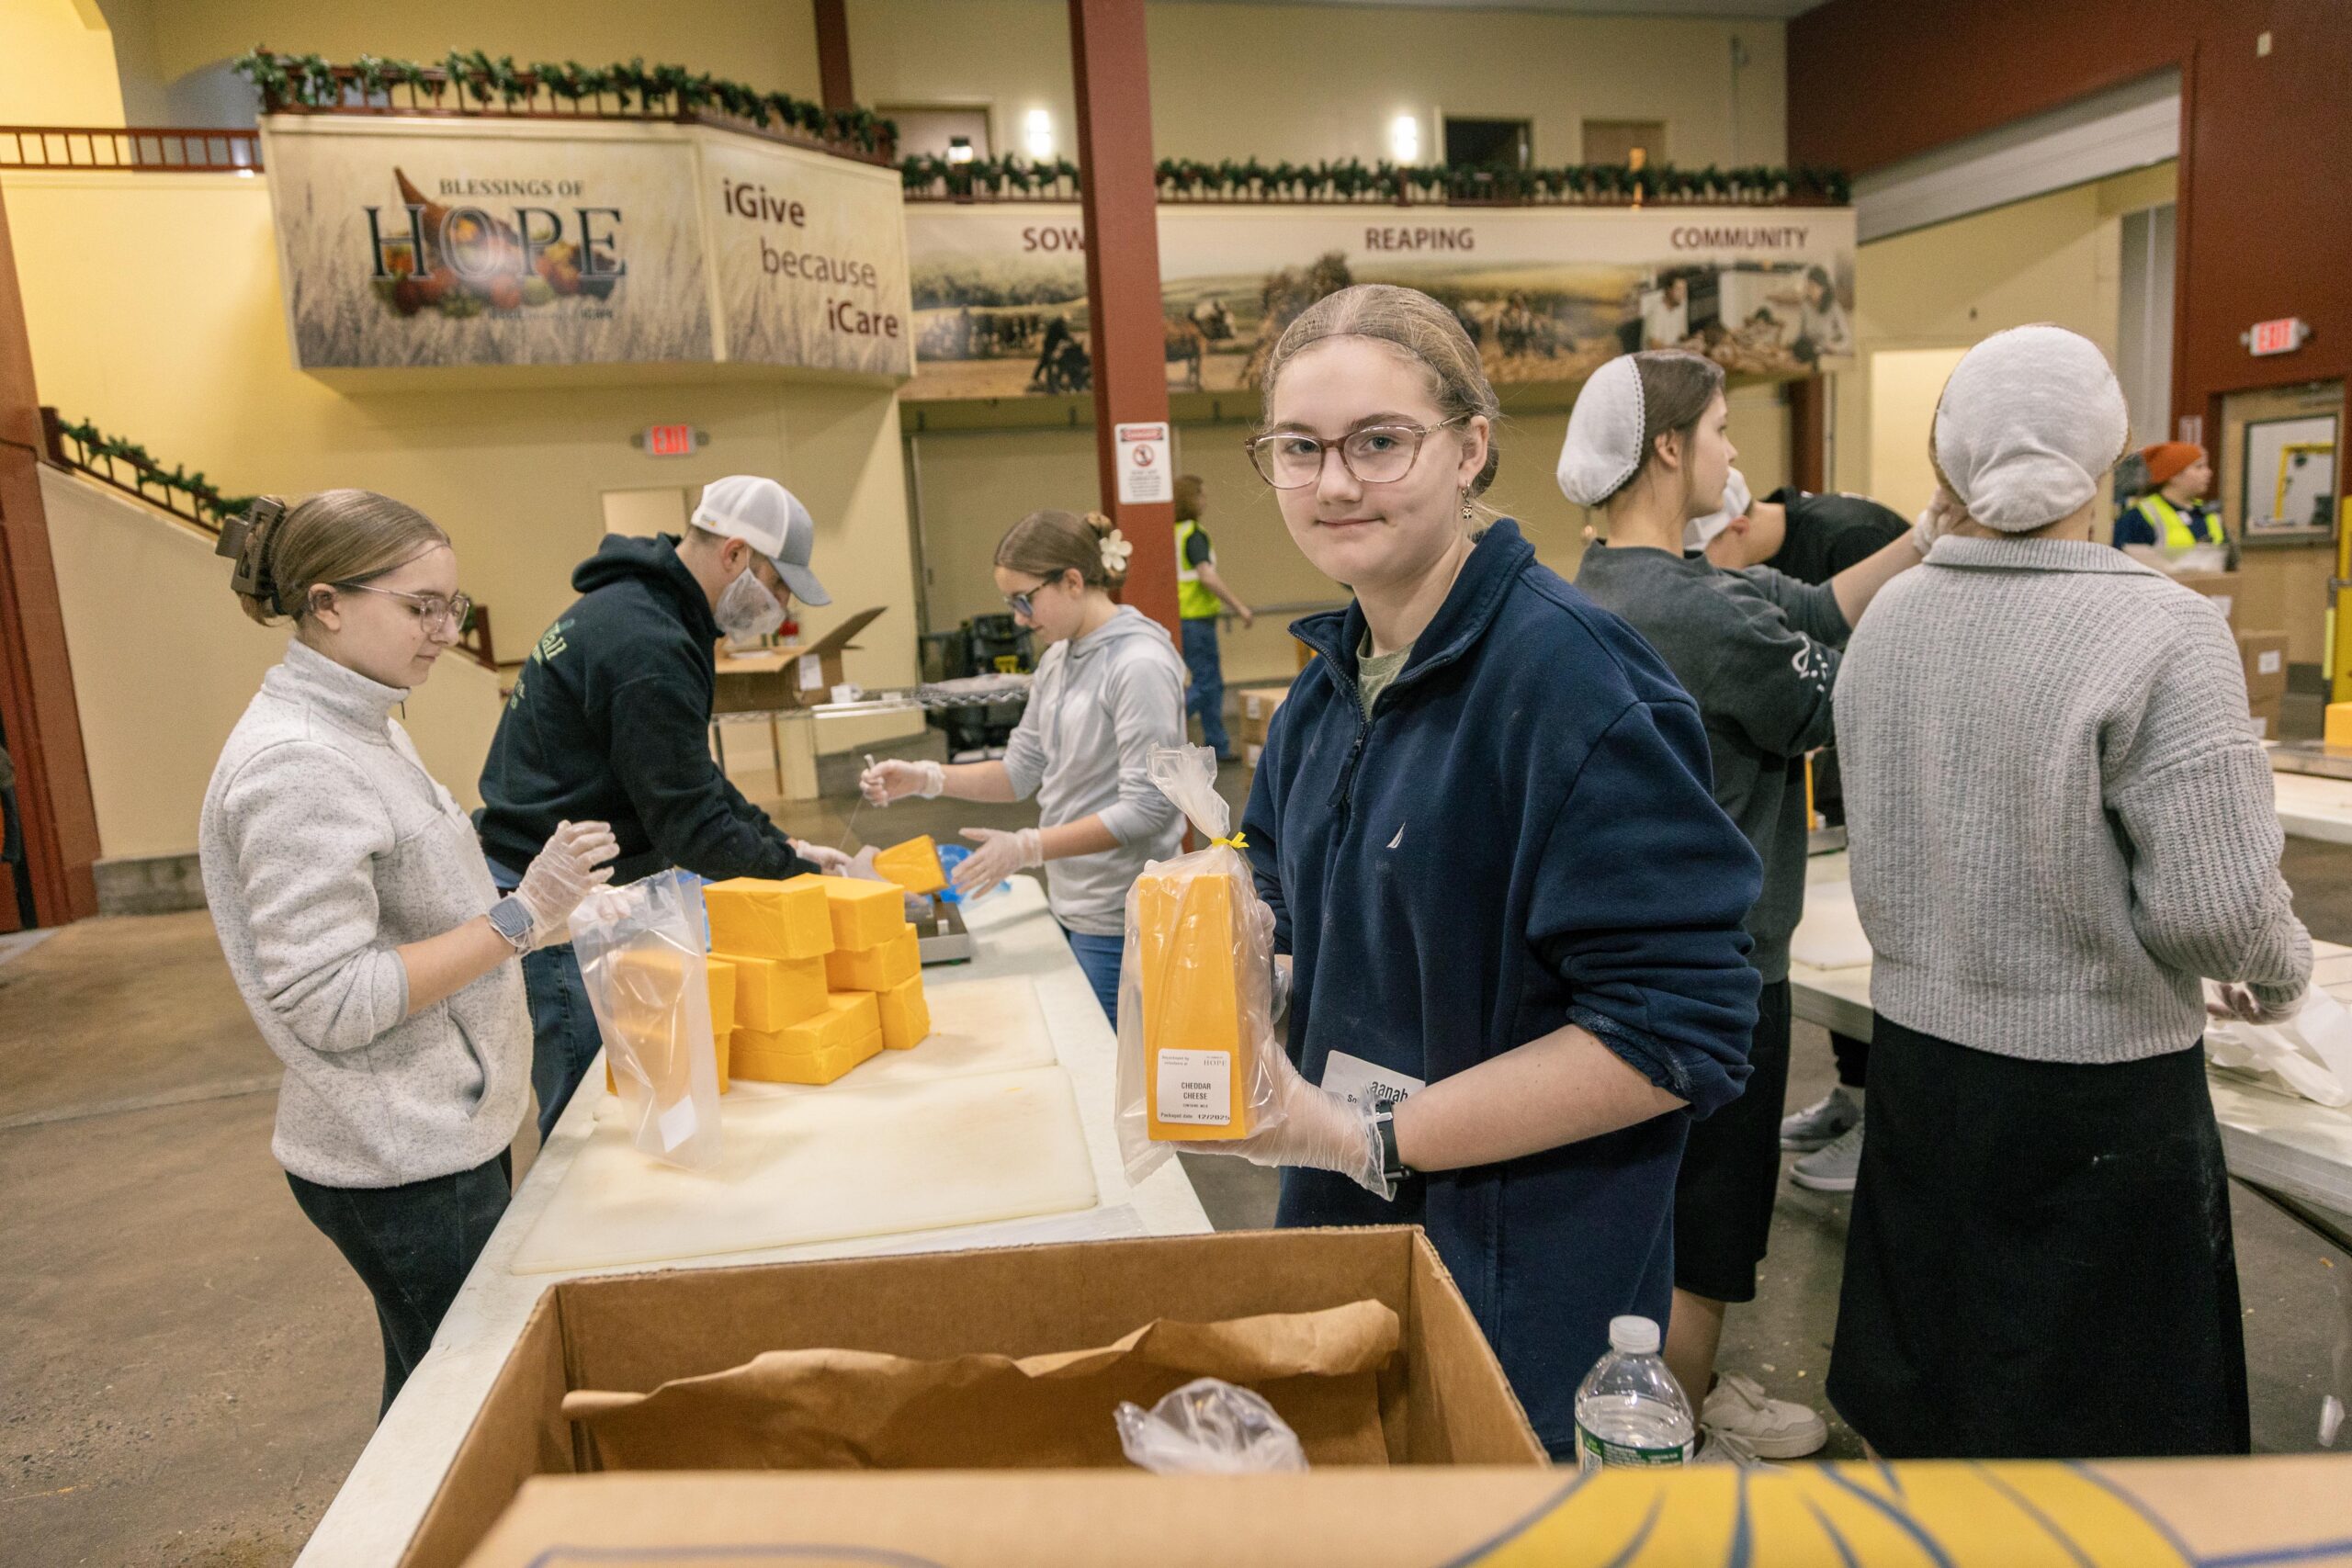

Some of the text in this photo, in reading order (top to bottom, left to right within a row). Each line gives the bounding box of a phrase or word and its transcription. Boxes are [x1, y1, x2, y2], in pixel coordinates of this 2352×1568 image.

[439, 178, 585, 197] BLESSINGS OF
[724, 178, 805, 228] iGive
[364, 203, 628, 280] HOPE
[1365, 227, 1475, 251] REAPING
[1671, 227, 1810, 250] COMMUNITY
[761, 235, 877, 289] because
[828, 298, 899, 338] iCare
[652, 425, 689, 456] EXIT
[1181, 1082, 1212, 1090] CHEDDAR
[1182, 1092, 1208, 1100] CHEESE
